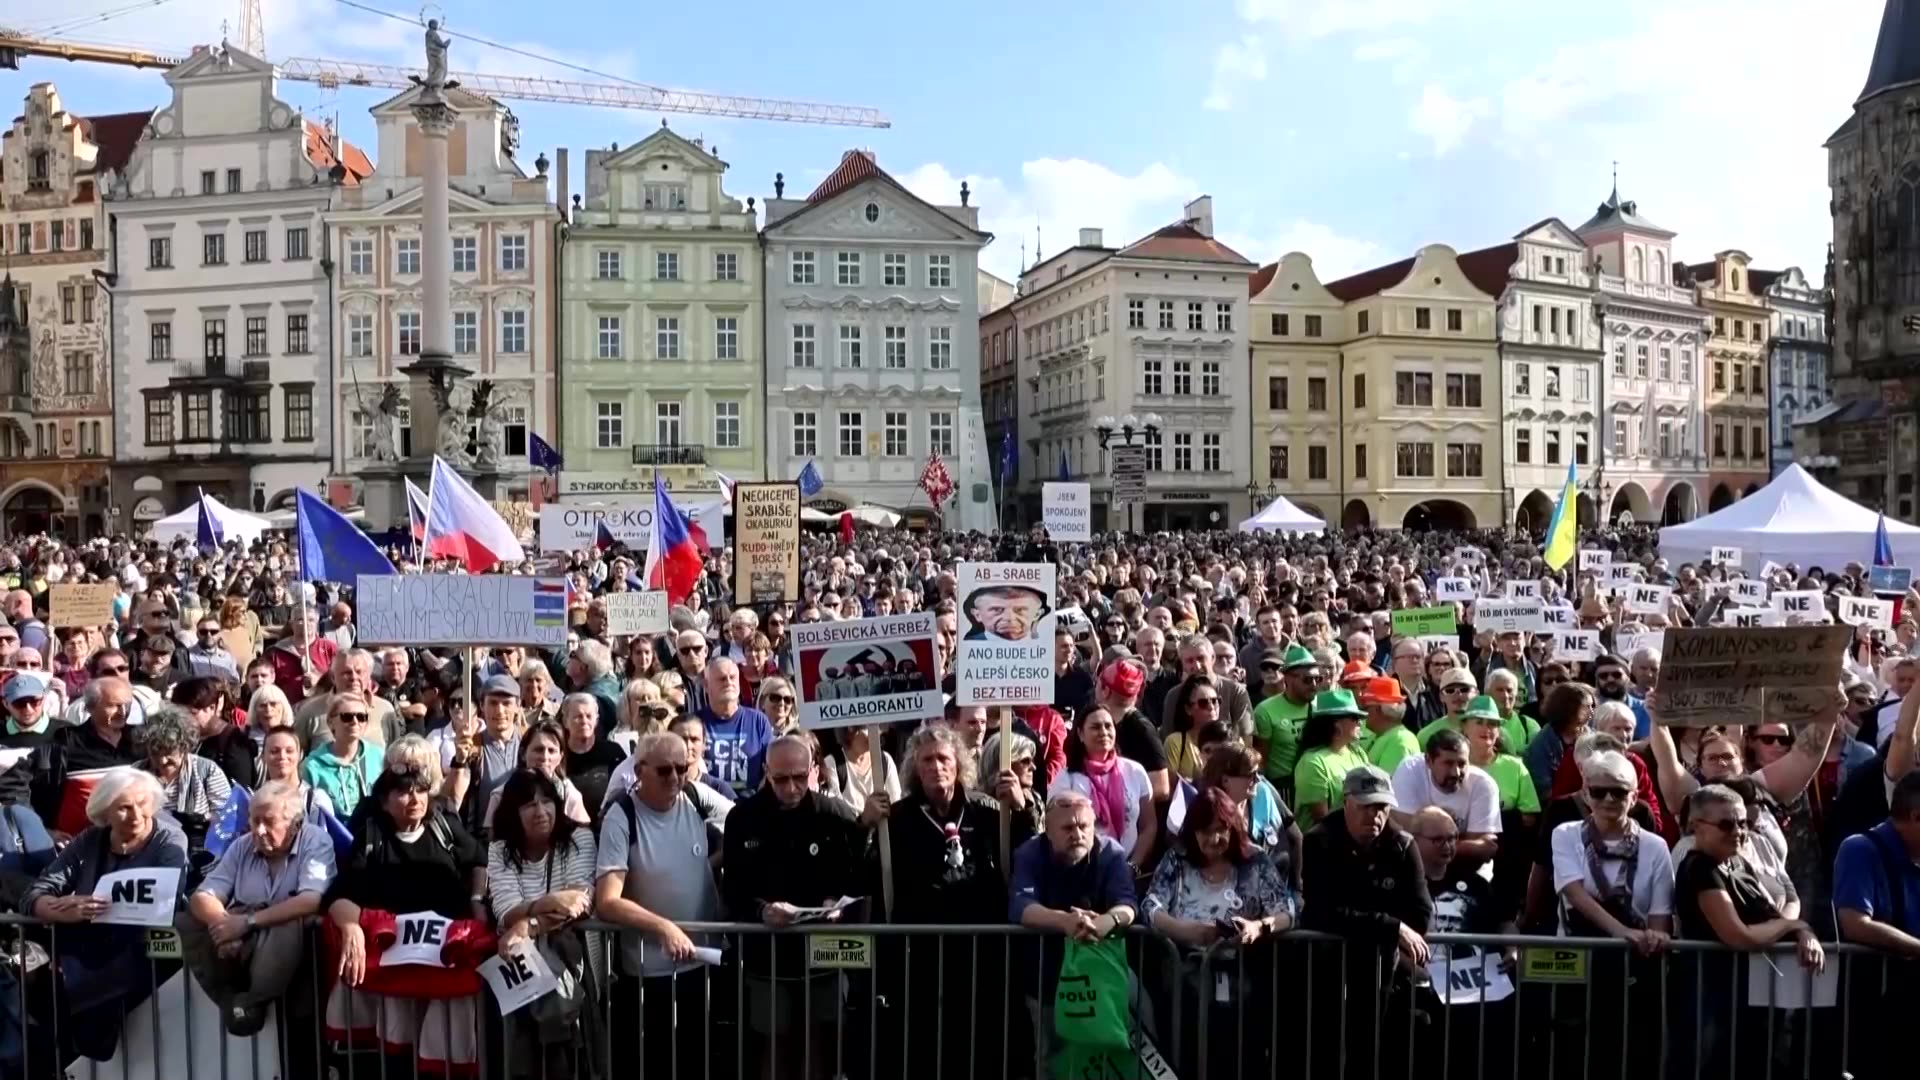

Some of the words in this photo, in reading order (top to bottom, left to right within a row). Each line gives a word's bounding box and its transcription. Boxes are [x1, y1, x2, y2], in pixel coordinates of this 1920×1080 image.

[742, 488, 796, 502] NECHCEME
[1057, 492, 1076, 501] JSEM
[761, 531, 778, 540] ANI
[1461, 551, 1473, 559] NE
[1588, 554, 1603, 564] NE
[1719, 550, 1734, 559] NE
[975, 568, 991, 579] AB
[1003, 568, 1040, 579] SRABE
[1612, 567, 1631, 579] NE
[1445, 582, 1465, 592] NE
[1515, 585, 1534, 597] NE
[1738, 583, 1758, 596] NE
[1636, 589, 1660, 603] NE
[1783, 597, 1810, 611] NE
[1509, 606, 1538, 616] VŠECHNO
[1544, 611, 1566, 623] NE
[1852, 604, 1880, 619] NE
[1057, 612, 1078, 625] NE
[1736, 614, 1762, 627] NE
[797, 622, 878, 643] BOLŠEVICKÁ
[881, 617, 930, 636] VERBEŽ
[1565, 636, 1588, 650] NE
[968, 648, 993, 660] ANO
[996, 648, 1026, 659] BUDE
[1031, 645, 1047, 659] LÍP
[965, 667, 973, 680] A
[976, 665, 1007, 680] LEPŠÍ
[1011, 664, 1049, 680] ČESKO
[973, 687, 996, 698] BEZ
[1000, 687, 1041, 699] TEBE!!!
[820, 692, 923, 719] KOLABORANTŮ
[111, 878, 157, 904] NE
[403, 919, 446, 945] NE
[813, 951, 839, 961] JOHNNY
[841, 951, 865, 961] SERVIS
[498, 953, 533, 989] NE
[1449, 966, 1491, 990] NE
